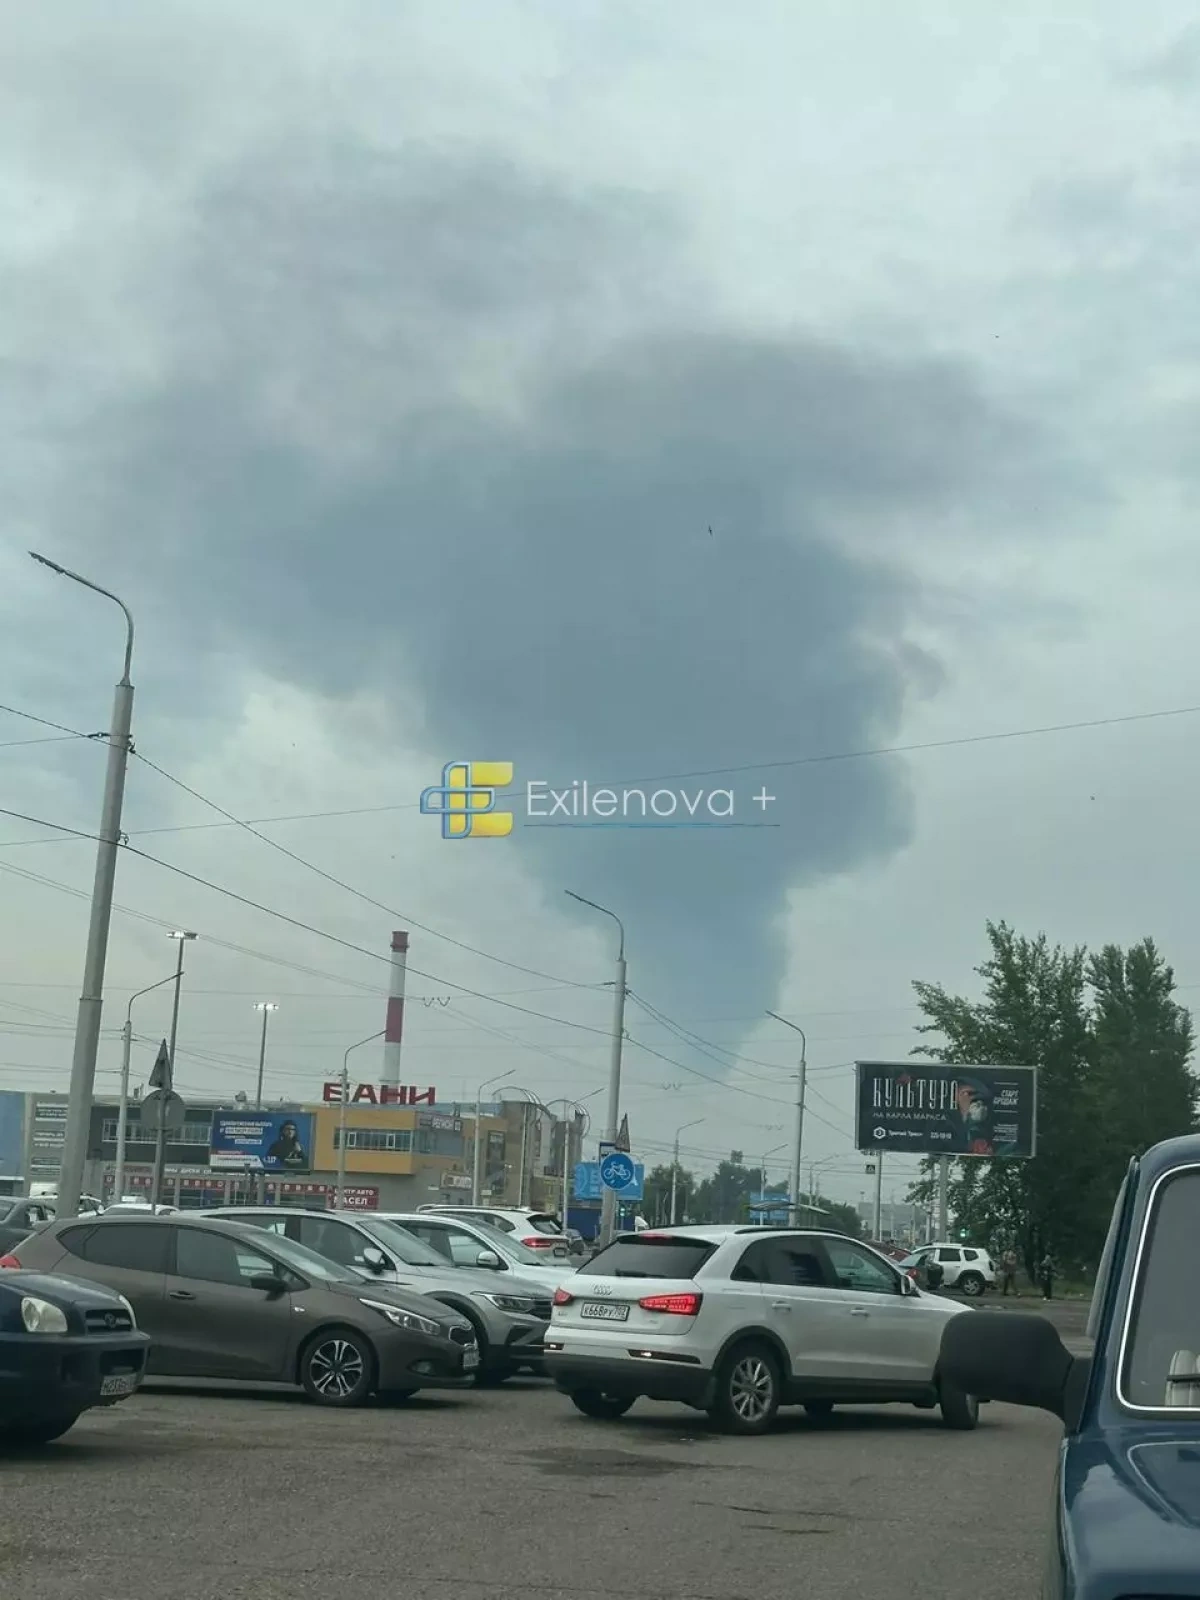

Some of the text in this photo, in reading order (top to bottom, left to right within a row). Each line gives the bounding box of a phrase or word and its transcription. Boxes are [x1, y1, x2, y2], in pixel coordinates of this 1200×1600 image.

[323, 1082, 436, 1106] БАНИ
[873, 1077, 959, 1111] КУЛЬТУРА
[886, 1112, 912, 1120] КАРЛА
[913, 1112, 947, 1121] МАРКСА
